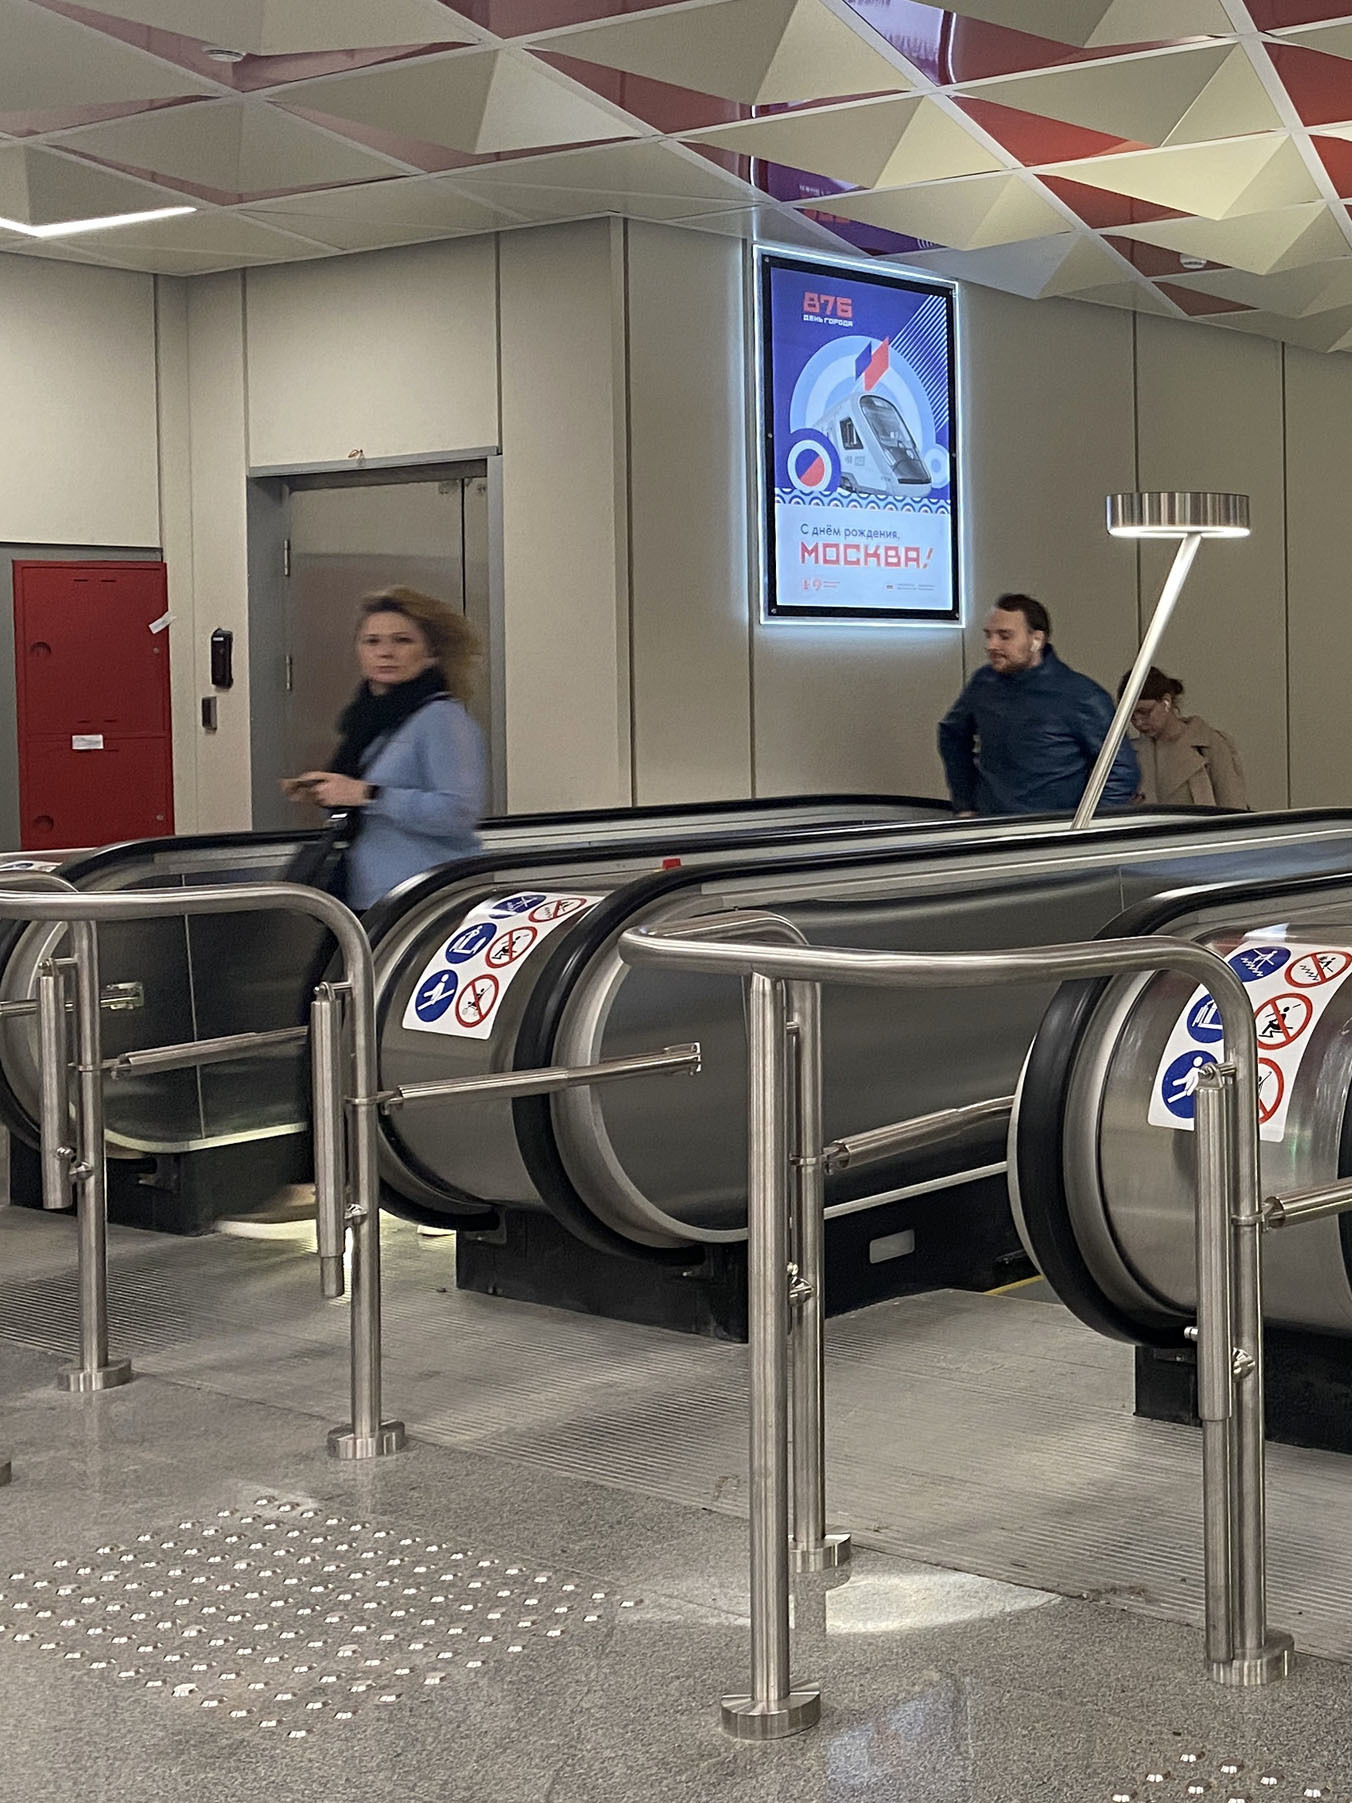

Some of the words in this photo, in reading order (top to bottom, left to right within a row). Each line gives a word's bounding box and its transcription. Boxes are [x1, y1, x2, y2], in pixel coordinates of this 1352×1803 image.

[804, 291, 852, 317] 876
[803, 314, 823, 323] ДЕНЬ
[824, 317, 853, 327] ГОРОДА
[800, 523, 809, 535] С
[812, 524, 841, 537] днём
[844, 528, 900, 540] рождения,
[800, 541, 934, 569] МОСКВА!
